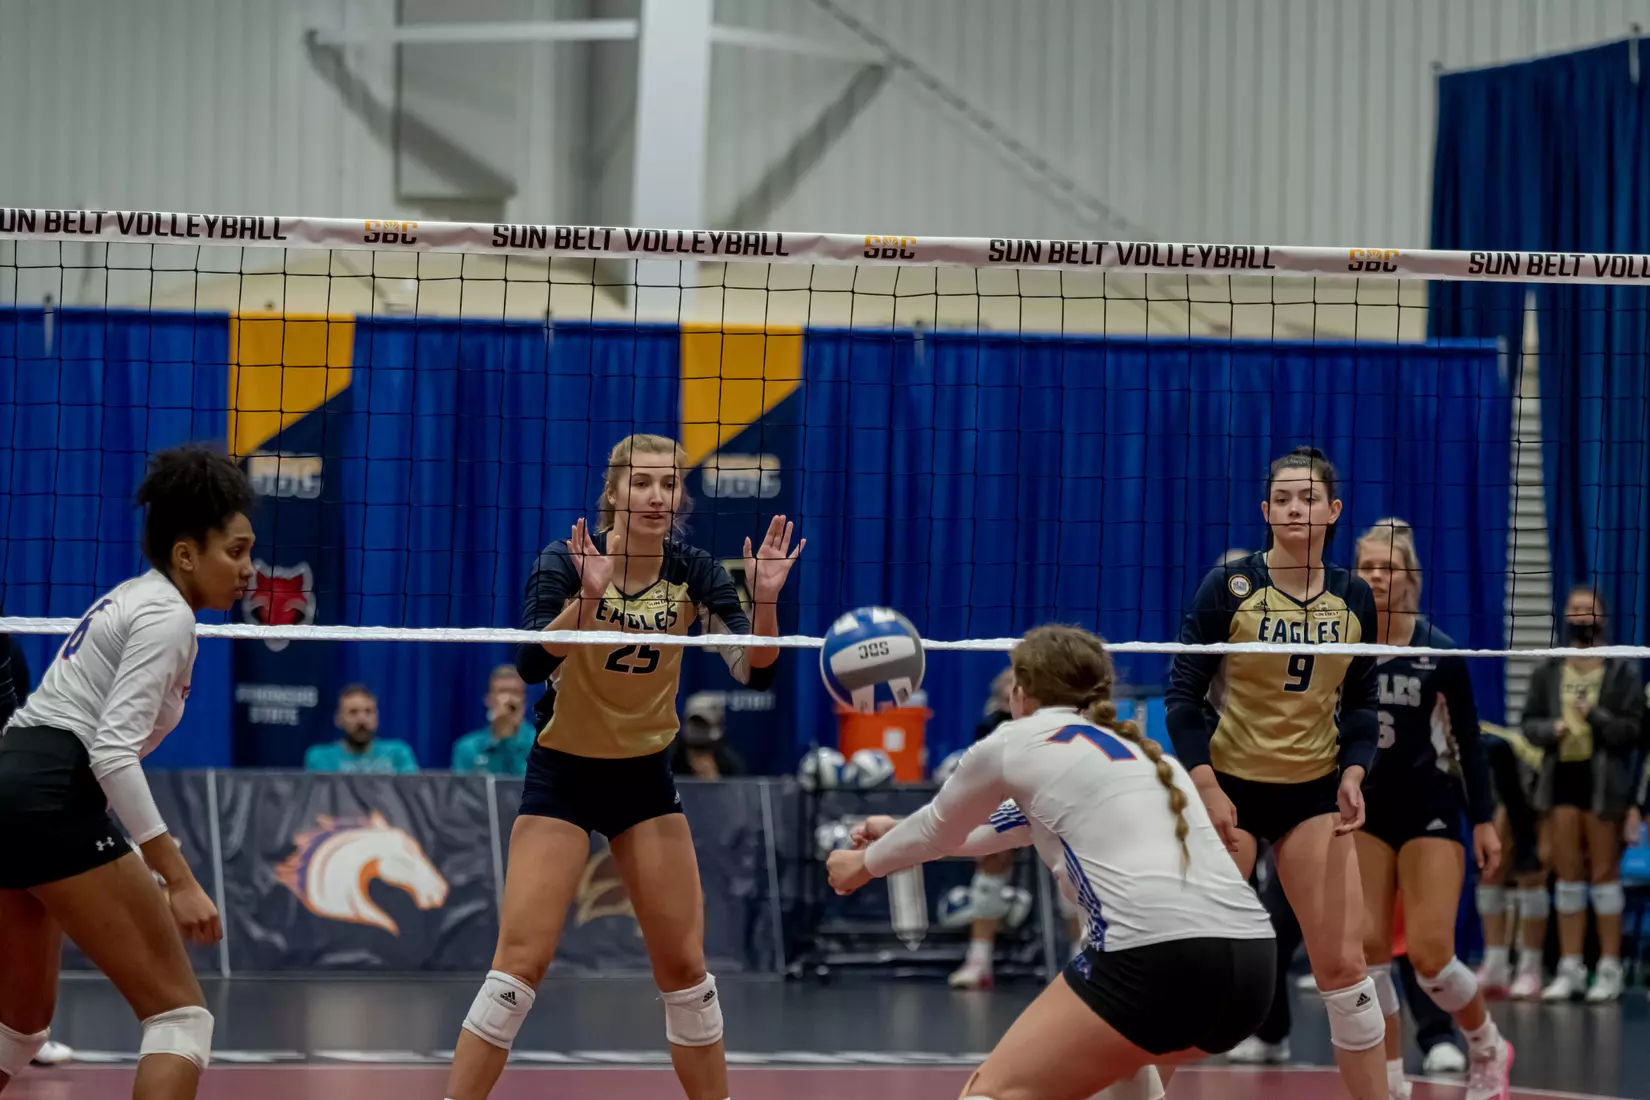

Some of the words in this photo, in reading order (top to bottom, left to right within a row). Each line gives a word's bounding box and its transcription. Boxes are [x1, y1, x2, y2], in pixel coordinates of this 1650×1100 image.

[44, 210, 108, 235] BELT
[116, 211, 288, 240] VOLLEYBALL
[363, 219, 418, 245] SBC
[492, 224, 547, 249] SUN
[553, 226, 616, 251] BELT
[624, 228, 789, 257] VOLLEYBALL
[863, 235, 917, 260] SBC
[988, 239, 1042, 263] SUN
[1048, 240, 1109, 266] BELT
[1115, 242, 1276, 270] VOLLEYBALL
[1348, 248, 1399, 273] SBC
[1468, 251, 1521, 276] SUN
[1526, 253, 1585, 278] BELT
[596, 598, 678, 631] EAGLES
[1258, 616, 1341, 644] EAGLES
[604, 644, 660, 674] 25
[1283, 653, 1315, 692] 9
